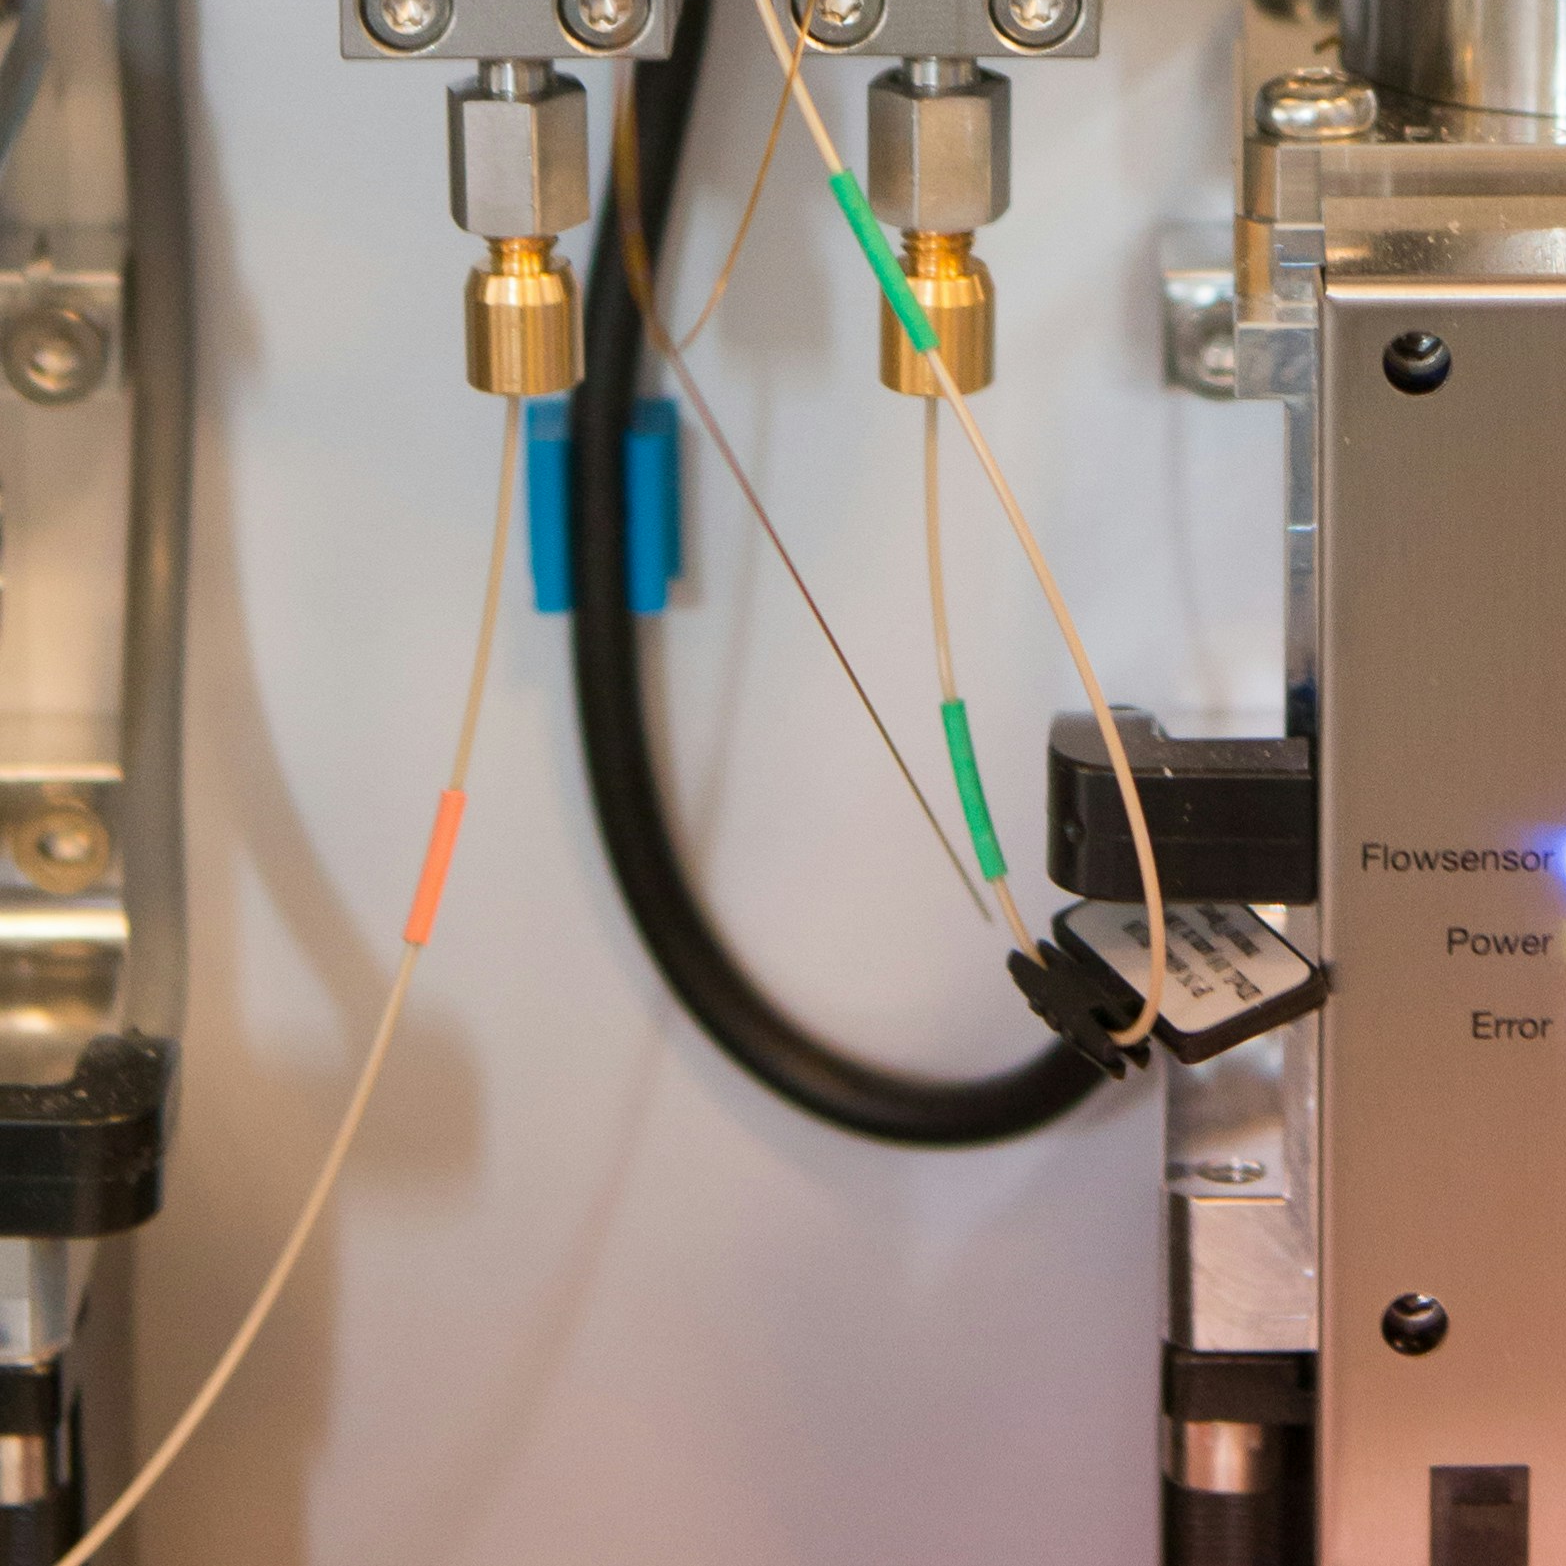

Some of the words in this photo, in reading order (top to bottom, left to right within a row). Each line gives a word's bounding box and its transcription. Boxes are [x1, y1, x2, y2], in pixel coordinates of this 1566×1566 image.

[1361, 842, 1554, 873] Flowsensor
[1446, 927, 1553, 958] Power
[1471, 1011, 1553, 1040] Error
